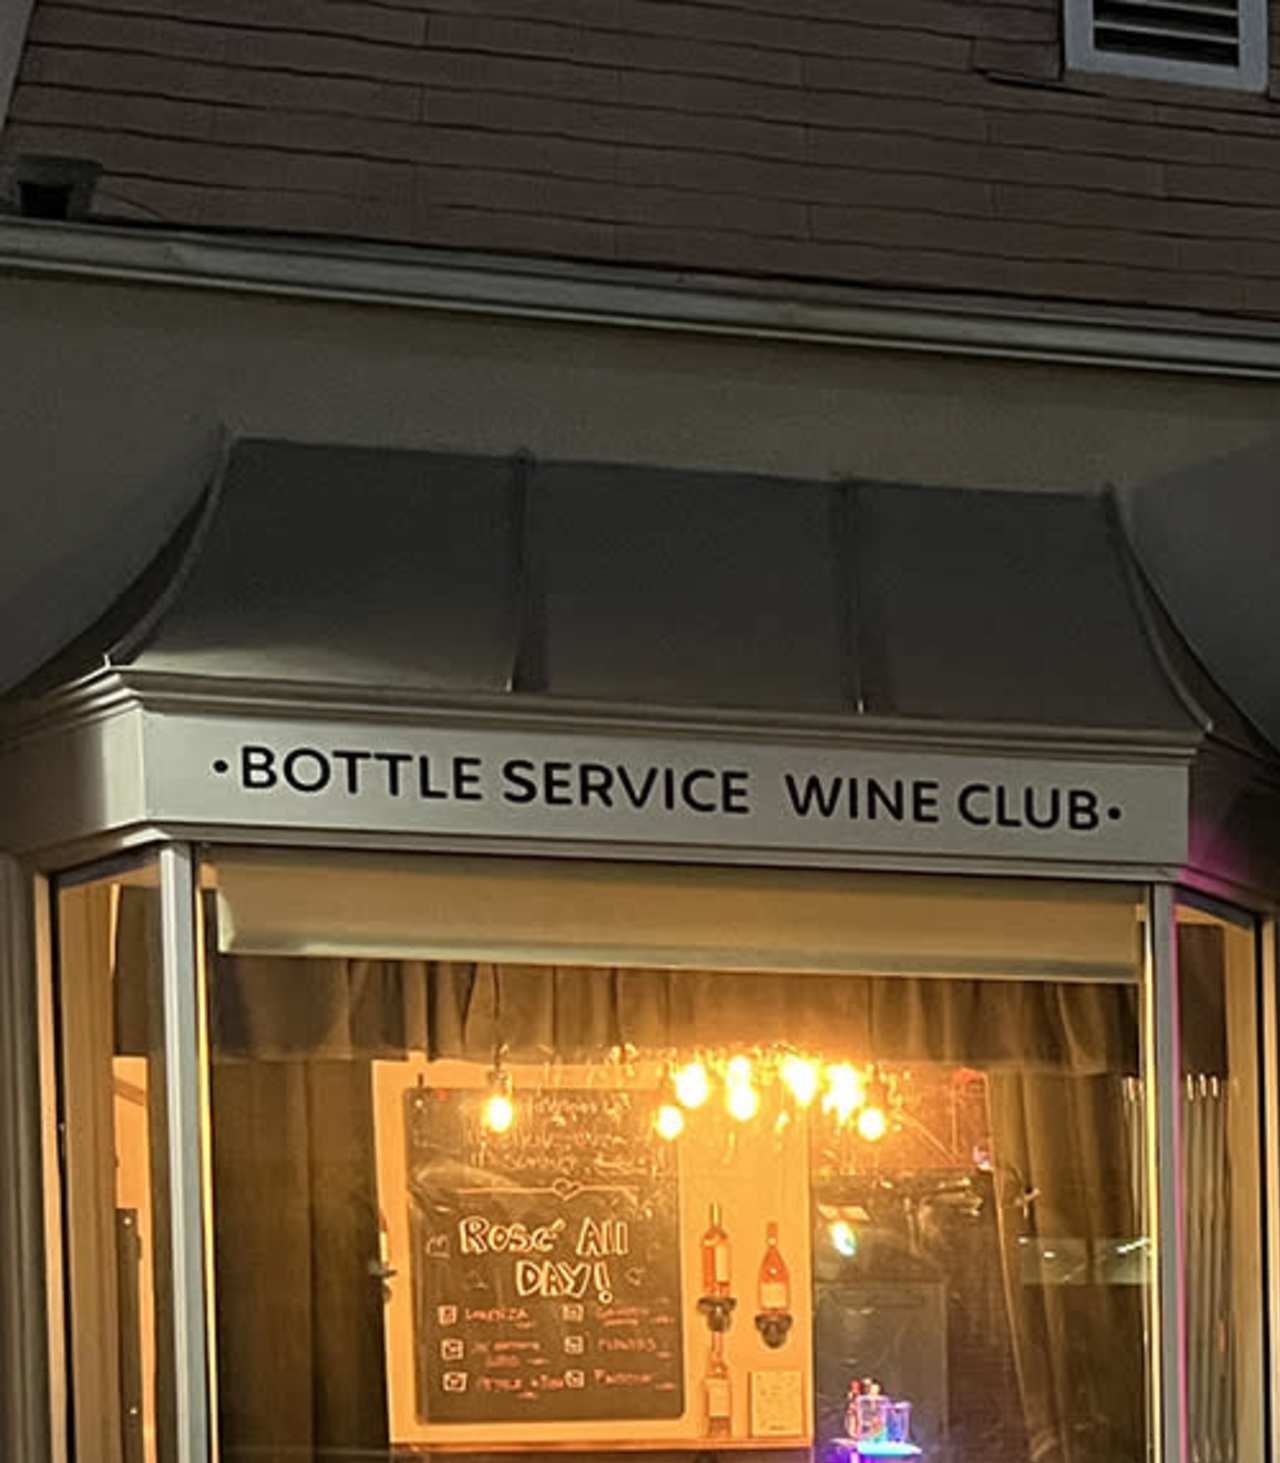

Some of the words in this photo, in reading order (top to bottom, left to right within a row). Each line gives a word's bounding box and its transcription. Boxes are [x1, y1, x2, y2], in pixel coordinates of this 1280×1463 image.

[240, 745, 483, 801] BOTTLE
[502, 760, 750, 814] SERVICE
[784, 773, 940, 823] WINE
[958, 783, 1100, 831] CLUB
[515, 1259, 613, 1304] DAY!
